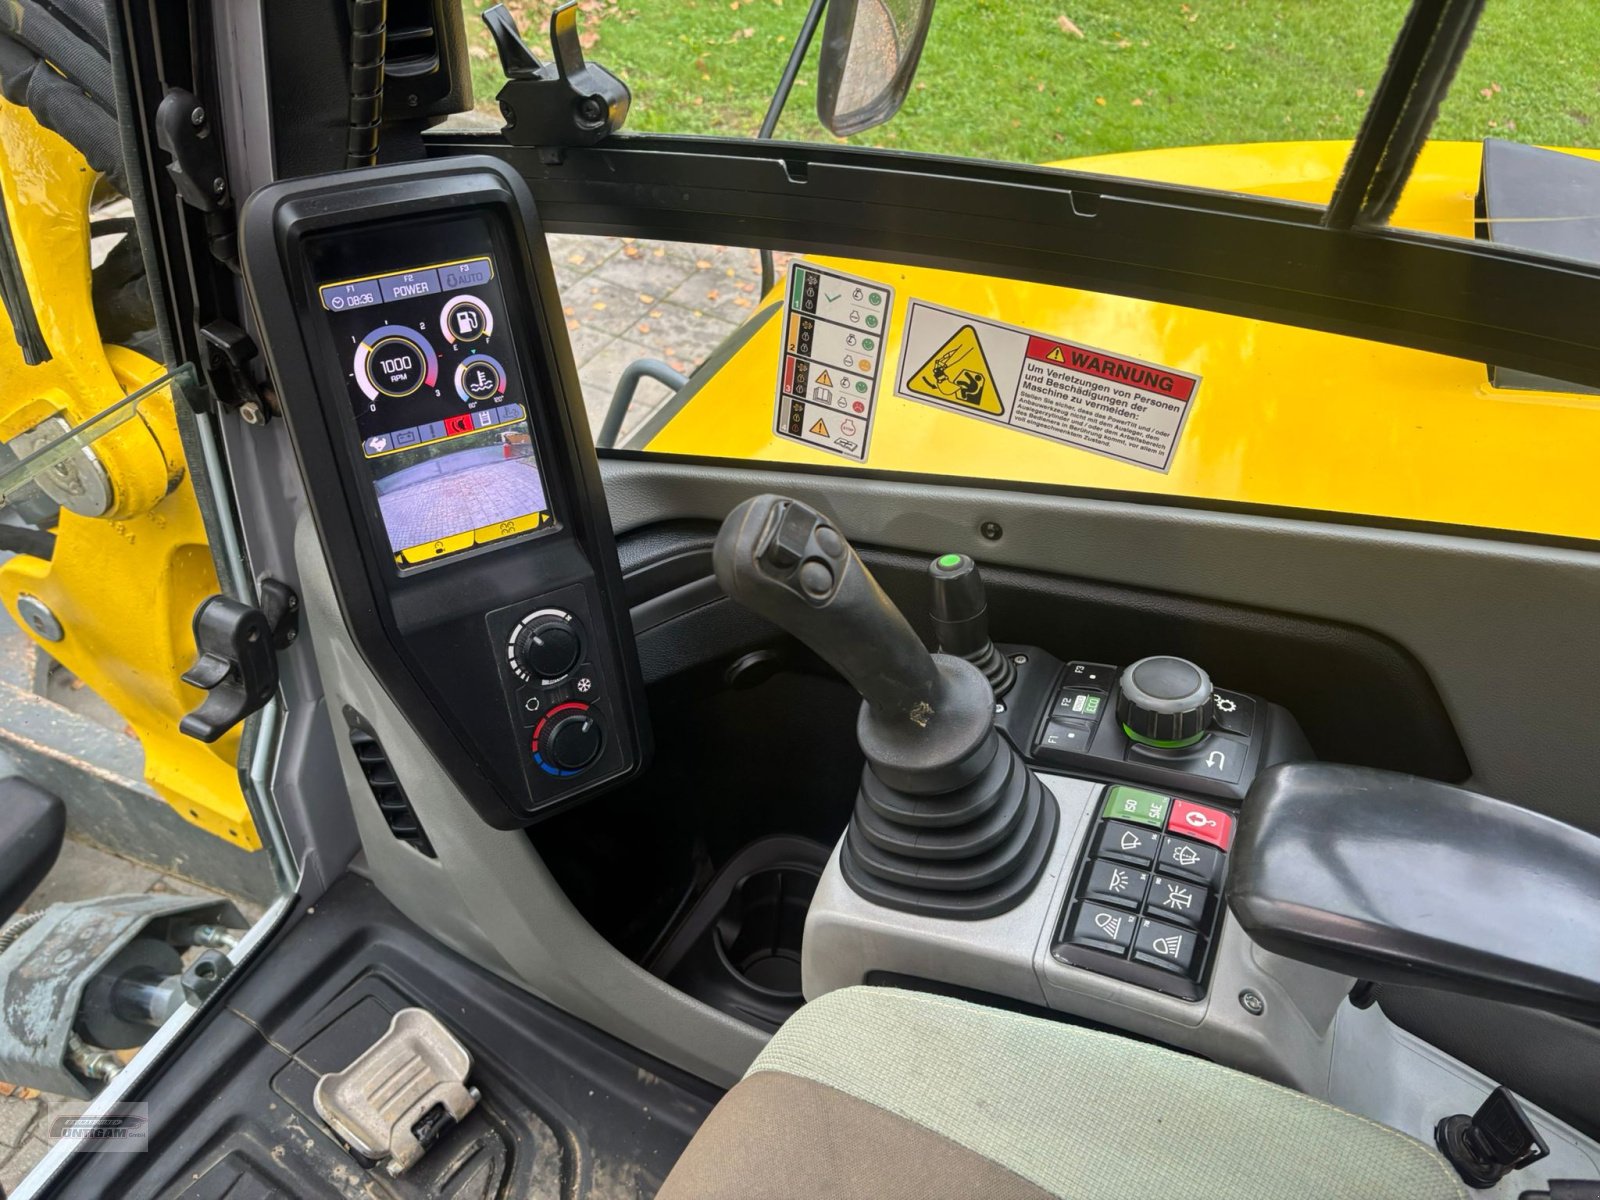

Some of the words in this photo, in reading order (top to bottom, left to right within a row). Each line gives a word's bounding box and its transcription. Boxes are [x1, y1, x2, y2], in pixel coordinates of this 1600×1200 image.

[460, 264, 470, 273] F3
[404, 274, 414, 283] F2
[458, 271, 483, 285] AUTO
[346, 285, 355, 294] F1
[393, 282, 429, 298] POWER
[347, 293, 374, 306] 08:36
[419, 322, 426, 331] 2
[789, 343, 796, 352] 2
[380, 355, 412, 375] 1000
[390, 373, 408, 383] RPM
[1072, 352, 1174, 392] WARNUNG
[435, 388, 441, 397] 3
[784, 384, 791, 393] 3
[1025, 372, 1043, 383] und
[1046, 378, 1127, 409] Beschädigungen
[1131, 402, 1147, 413] der
[1027, 363, 1043, 374] Um
[1046, 368, 1110, 394] Verletzungen
[1113, 388, 1130, 398] von
[1134, 393, 1180, 412] Personen
[1023, 381, 1068, 400] Maschine
[1071, 396, 1081, 404] zu
[1085, 398, 1139, 420] vermeiden:
[370, 404, 376, 413] 0
[1019, 397, 1068, 416] Anbauwerkzeug
[1071, 412, 1085, 420] nicht
[1099, 420, 1112, 428] dem
[1146, 433, 1159, 441] dem
[1108, 416, 1136, 428] PowerTilt
[1071, 418, 1083, 426] und
[1088, 423, 1102, 431] oder
[1104, 428, 1117, 436] dem
[1140, 445, 1157, 453] allem
[1074, 665, 1085, 674] F3
[1061, 697, 1072, 707] F2
[1087, 698, 1099, 713] ECO
[1048, 735, 1058, 744] F1
[1124, 799, 1137, 813] ISO
[1149, 803, 1162, 818] SAE
